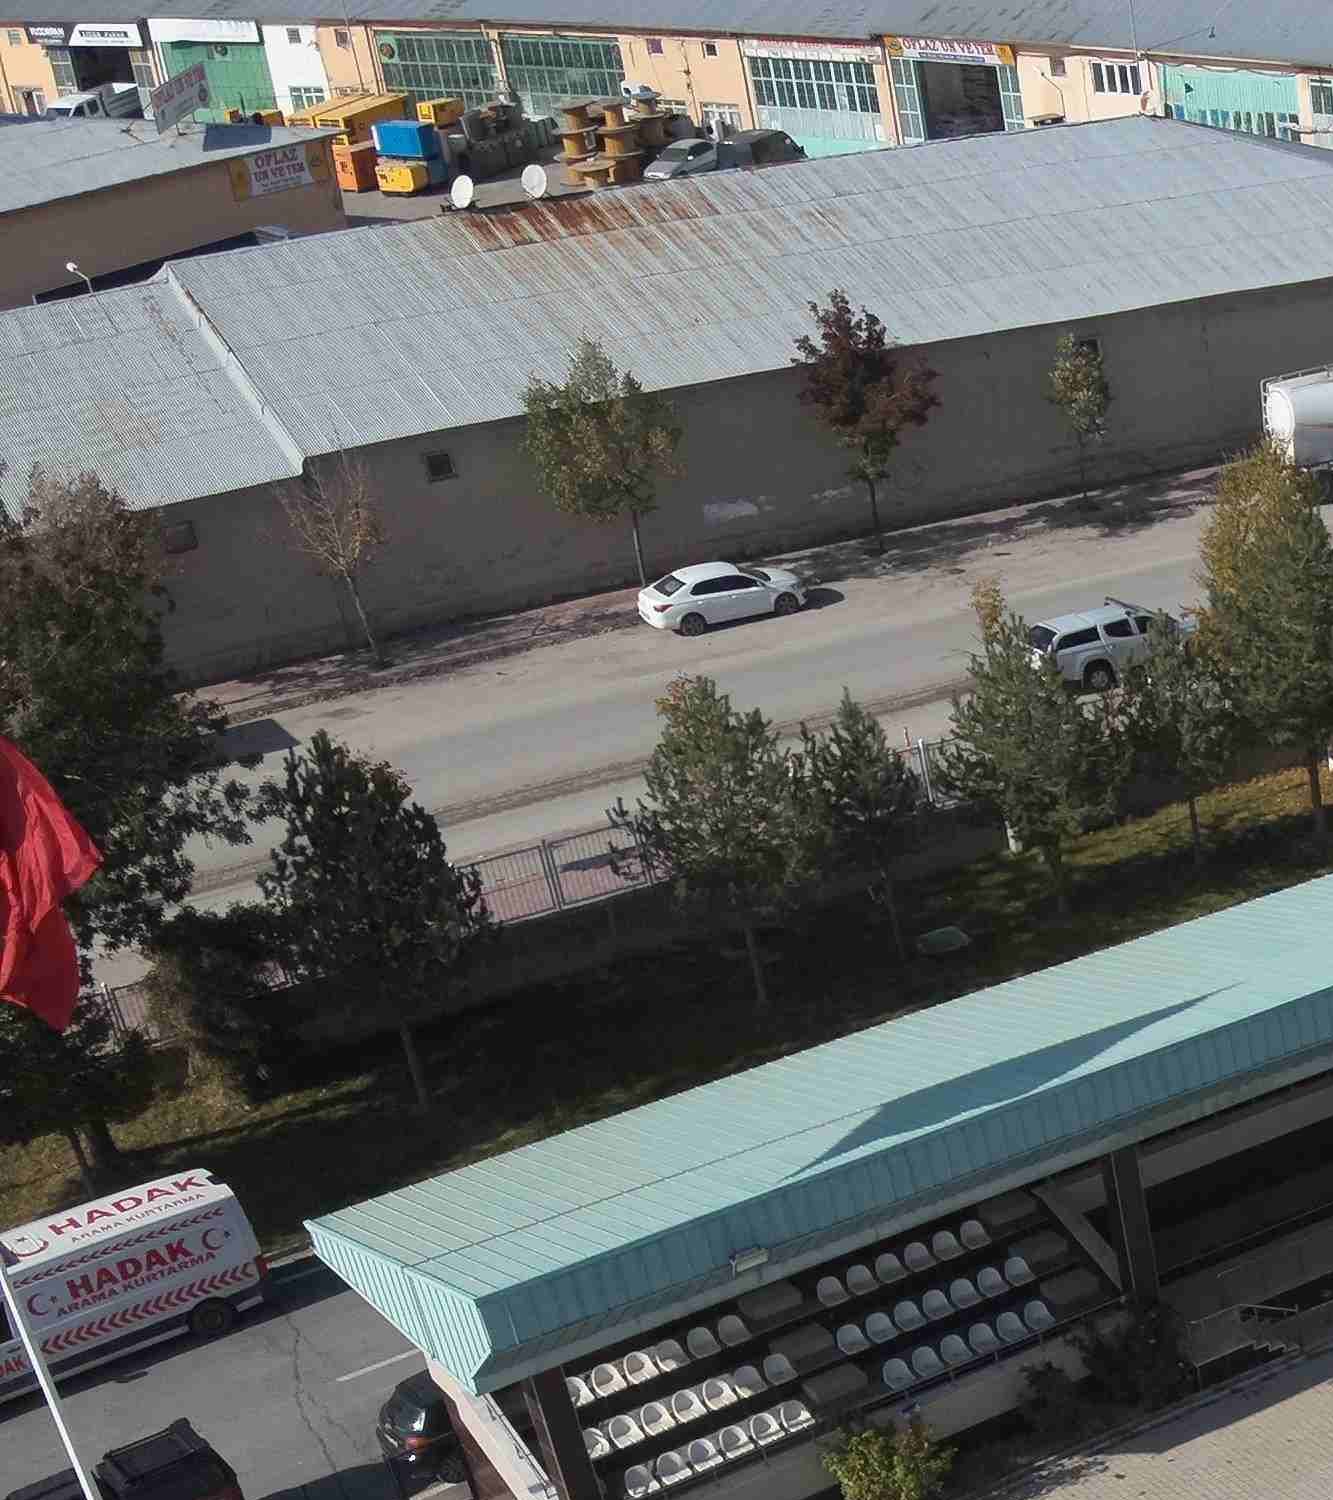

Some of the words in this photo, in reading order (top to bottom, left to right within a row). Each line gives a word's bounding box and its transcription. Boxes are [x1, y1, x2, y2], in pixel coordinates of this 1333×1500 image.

[48, 1175, 206, 1235] HADAK
[71, 1219, 126, 1243] ARAMA
[126, 1192, 205, 1223] KURTARMA
[55, 1286, 120, 1317] ARAMA
[120, 1250, 216, 1293] KURTARMA
[65, 1237, 195, 1300] HADAK
